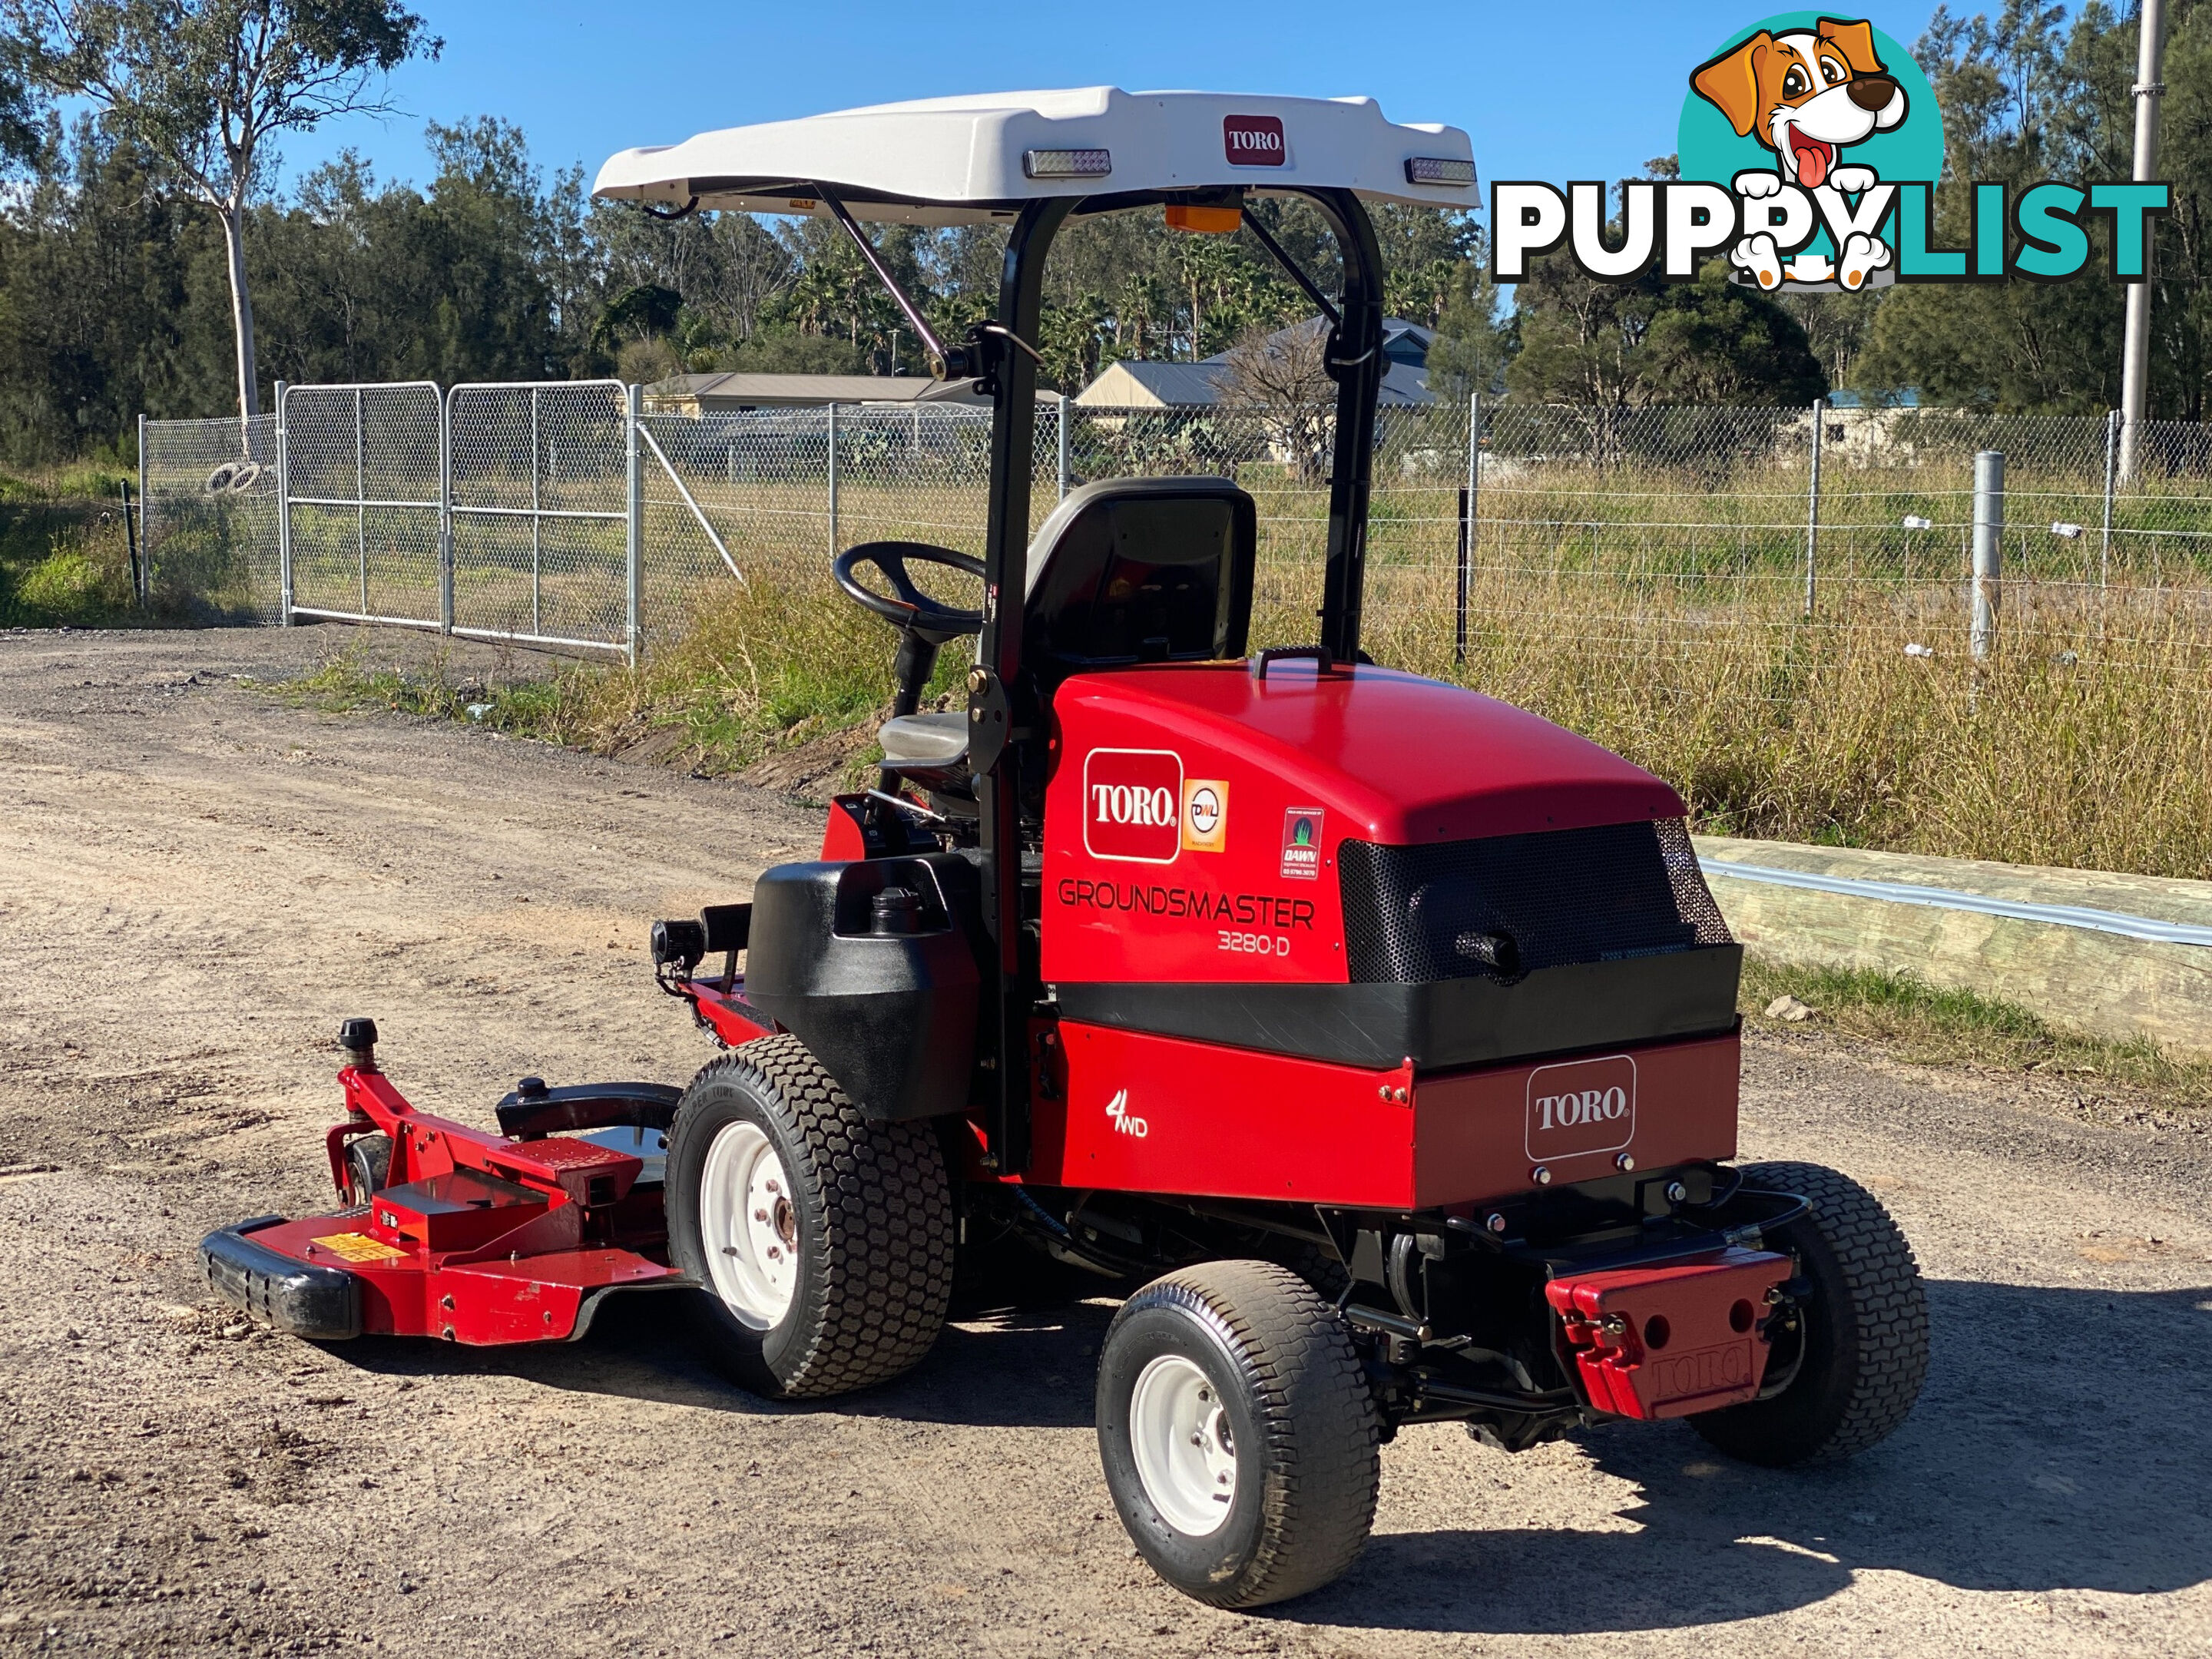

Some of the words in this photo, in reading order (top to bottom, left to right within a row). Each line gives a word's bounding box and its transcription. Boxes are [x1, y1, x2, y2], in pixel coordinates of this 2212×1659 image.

[1228, 131, 1280, 151] TORO
[1092, 784, 1174, 826] TORO
[1192, 803, 1219, 817] DWL
[1284, 849, 1317, 862] DAWN
[1058, 879, 1315, 930] GROUNDSMASTER
[1536, 1087, 1626, 1131] TORO
